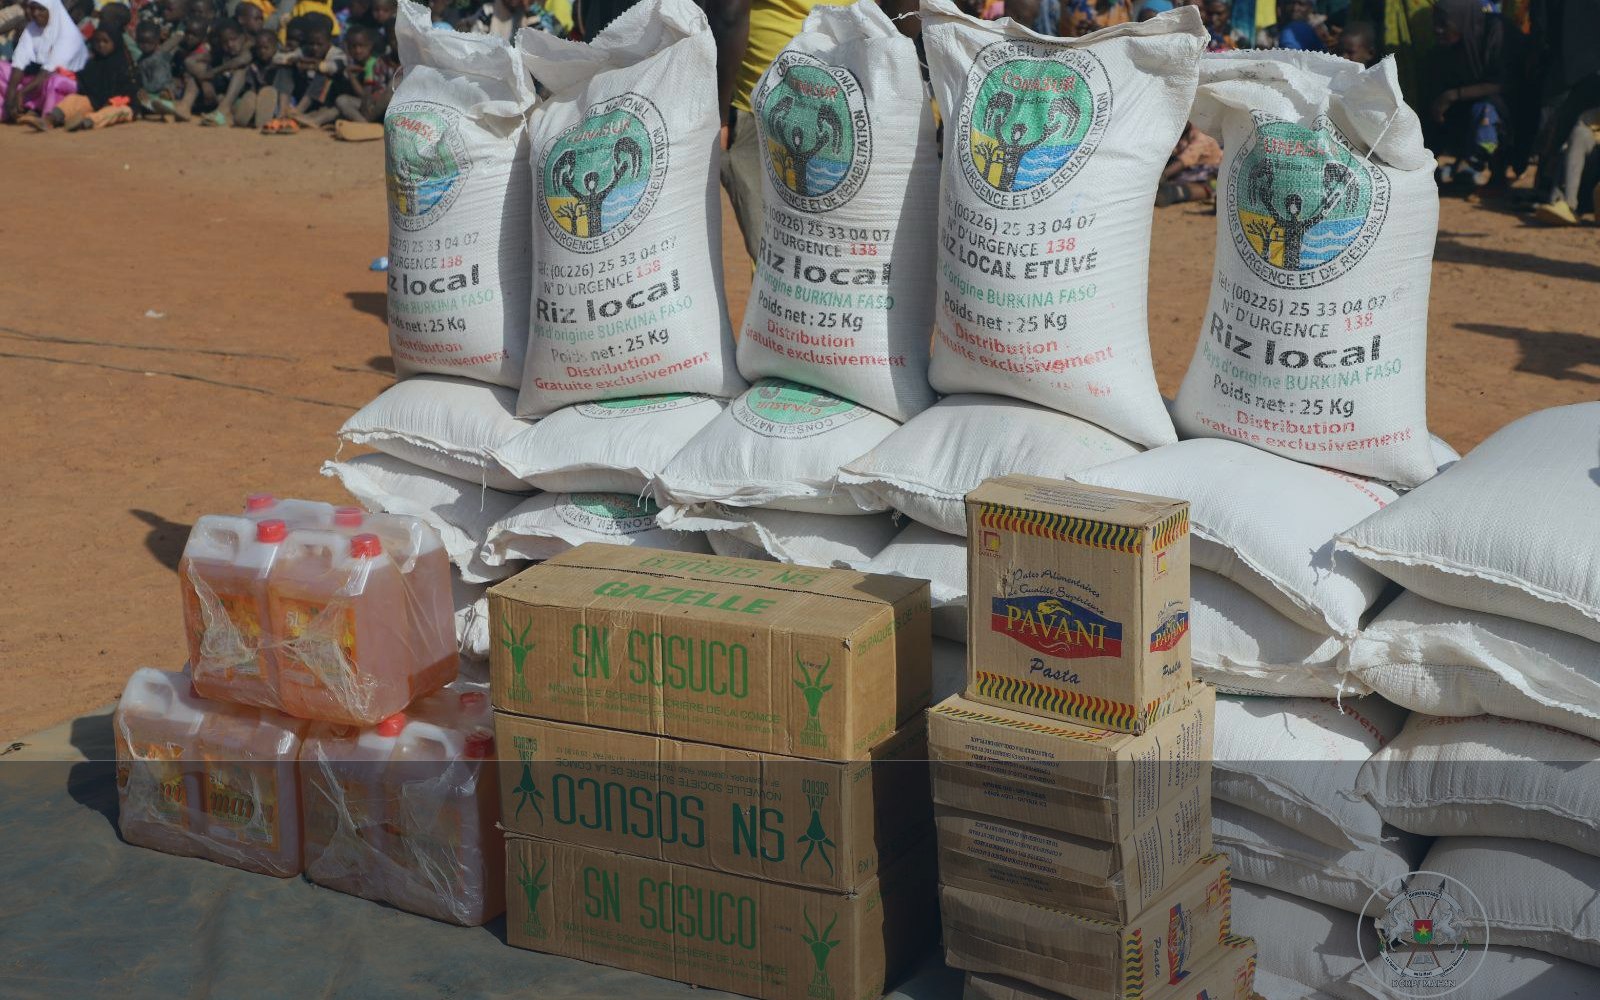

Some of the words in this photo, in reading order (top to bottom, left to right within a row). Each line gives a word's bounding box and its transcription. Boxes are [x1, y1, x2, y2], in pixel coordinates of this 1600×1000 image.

[823, 192, 839, 208] DE
[1012, 193, 1028, 205] ET
[1030, 184, 1051, 201] DE
[549, 221, 600, 250] D'URGENCE
[602, 233, 617, 246] ET
[617, 221, 633, 236] DE
[808, 221, 824, 238] 25
[828, 227, 845, 239] 33
[850, 228, 868, 242] 04
[873, 229, 891, 242] 07
[1001, 221, 1021, 236] 25
[1026, 222, 1046, 236] 33
[1051, 217, 1072, 233] 04
[1077, 213, 1097, 230] 07
[444, 237, 459, 248] 04
[463, 232, 479, 246] 07
[773, 228, 842, 258] D'URGENCE
[850, 242, 878, 257] 138
[957, 225, 1039, 258] D'URGENCE
[1046, 237, 1076, 254] 138
[440, 256, 463, 269] 138
[598, 261, 615, 274] 25
[620, 252, 637, 267] 33
[759, 237, 786, 274] Riz
[794, 256, 892, 286] local
[958, 245, 1016, 279] LOCAL
[1300, 272, 1316, 286] ET
[1319, 263, 1341, 279] DE
[402, 263, 480, 296] local
[557, 270, 634, 296] D'URGENCE
[462, 290, 494, 308] FASO
[536, 297, 577, 324] Riz
[587, 268, 680, 322] local
[795, 285, 853, 309] BURKINA
[857, 295, 895, 311] FASO
[987, 289, 1054, 309] BURKINA
[1059, 283, 1097, 303] FASO
[1289, 302, 1310, 316] 25
[1316, 302, 1337, 316] 33
[1342, 300, 1363, 315] 04
[429, 318, 445, 332] 25
[448, 316, 466, 332] Kg
[597, 312, 657, 340] BURKINA
[661, 295, 693, 317] FASO
[758, 290, 782, 318] Poids
[817, 312, 837, 328] 25
[841, 312, 864, 333] Kg
[944, 290, 973, 322] Poids
[1016, 315, 1038, 333] 25
[1044, 311, 1067, 330] Kg
[1236, 306, 1330, 339] D'URGENCE
[1344, 312, 1373, 333] 138
[625, 335, 645, 352] 25
[648, 328, 670, 346] Kg
[767, 319, 855, 349] Distribution
[954, 321, 1058, 354] Distribution
[1210, 312, 1252, 360] Riz
[1264, 334, 1381, 369] local
[534, 377, 593, 391] Gratuite
[596, 351, 711, 390] exclusivement
[566, 353, 662, 378] Distribution
[787, 347, 906, 368] exclusivement
[979, 345, 1115, 374] exclusivement
[1285, 369, 1361, 390] BURKINA
[1365, 358, 1402, 383] FASO
[1214, 374, 1251, 405] Poids
[1299, 399, 1323, 416] 25
[1329, 397, 1355, 418] Kg
[1236, 410, 1355, 435] Distribution
[1266, 427, 1413, 452] exclusivement
[593, 580, 778, 616] GAZELLE
[1005, 604, 1106, 651] PAVANI
[571, 623, 610, 680] SN
[628, 628, 748, 700] SOSUCO
[1029, 657, 1081, 684] Pasta
[1162, 660, 1182, 677] Pasta
[611, 766, 623, 776] DE
[727, 784, 782, 801] NOUVELLE
[552, 773, 705, 849] SOSUCO
[732, 802, 785, 863] SN
[583, 866, 621, 923] SN
[639, 876, 756, 950] SOSUCO
[1153, 936, 1161, 978] Pasta
